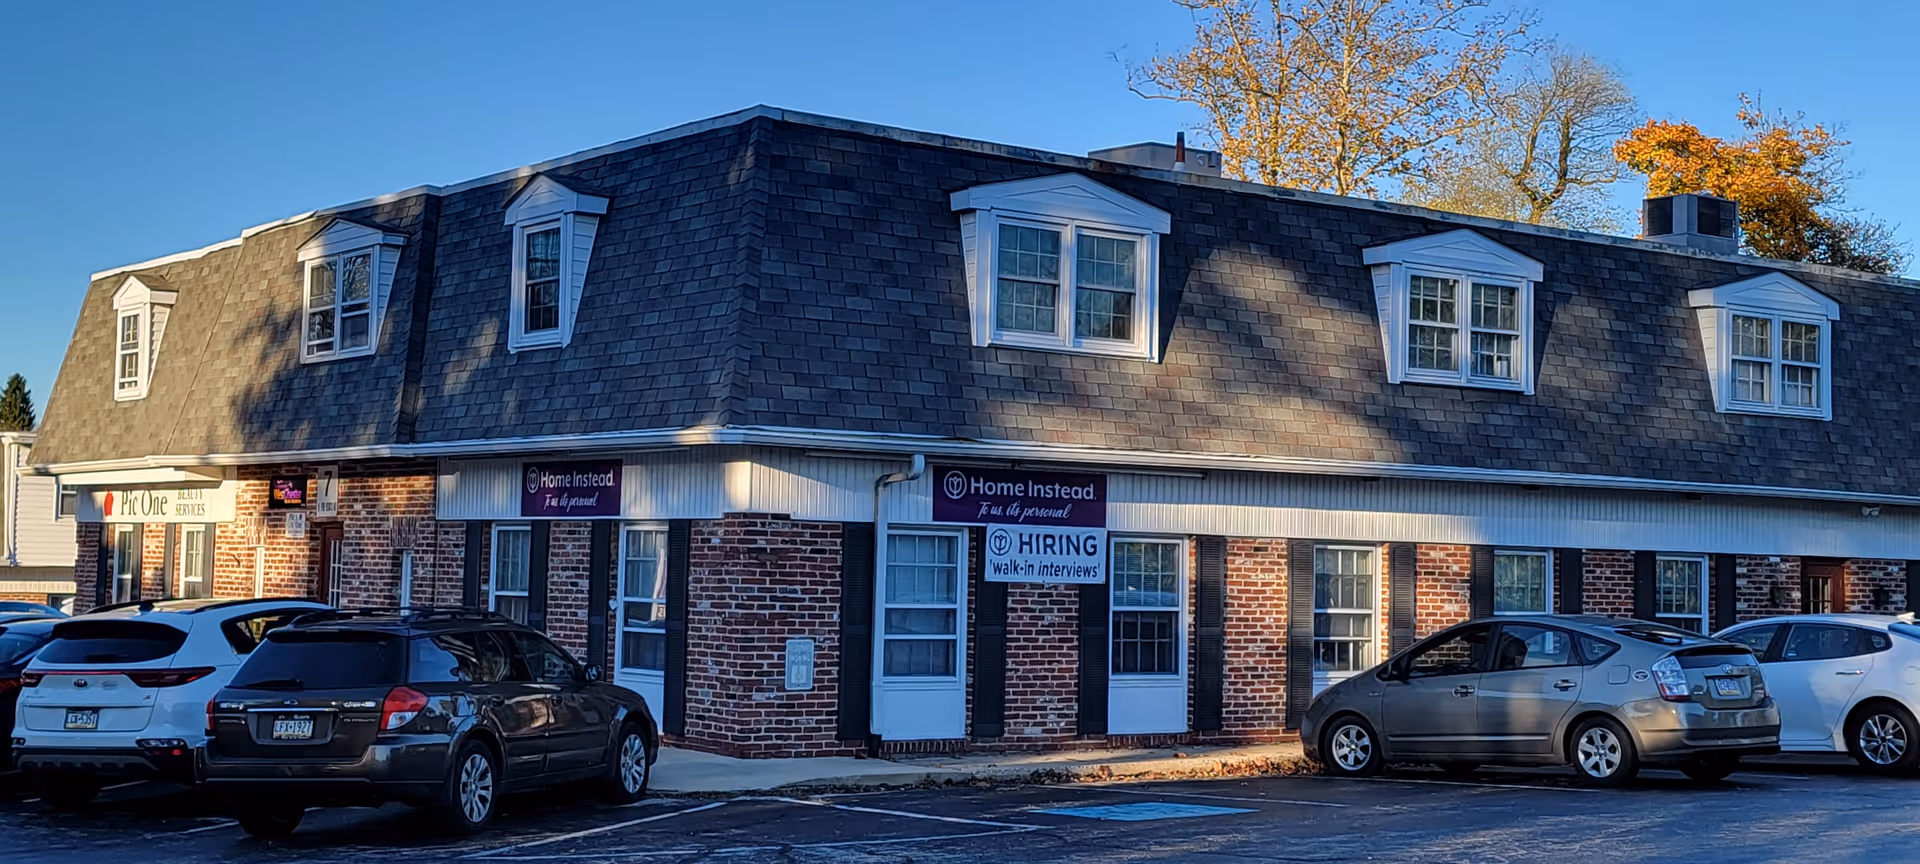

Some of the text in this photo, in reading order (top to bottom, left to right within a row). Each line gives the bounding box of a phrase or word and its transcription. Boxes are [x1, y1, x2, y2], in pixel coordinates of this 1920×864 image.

[324, 470, 333, 497] 7
[540, 471, 571, 488] Home
[970, 477, 1025, 496] Home
[121, 490, 168, 516] Pic One
[177, 488, 203, 500] BEAUTY
[566, 491, 599, 513] personal
[175, 503, 206, 516] SERVICES
[977, 502, 991, 519] To
[1018, 503, 1073, 522] personal
[1018, 533, 1098, 556] HIRING
